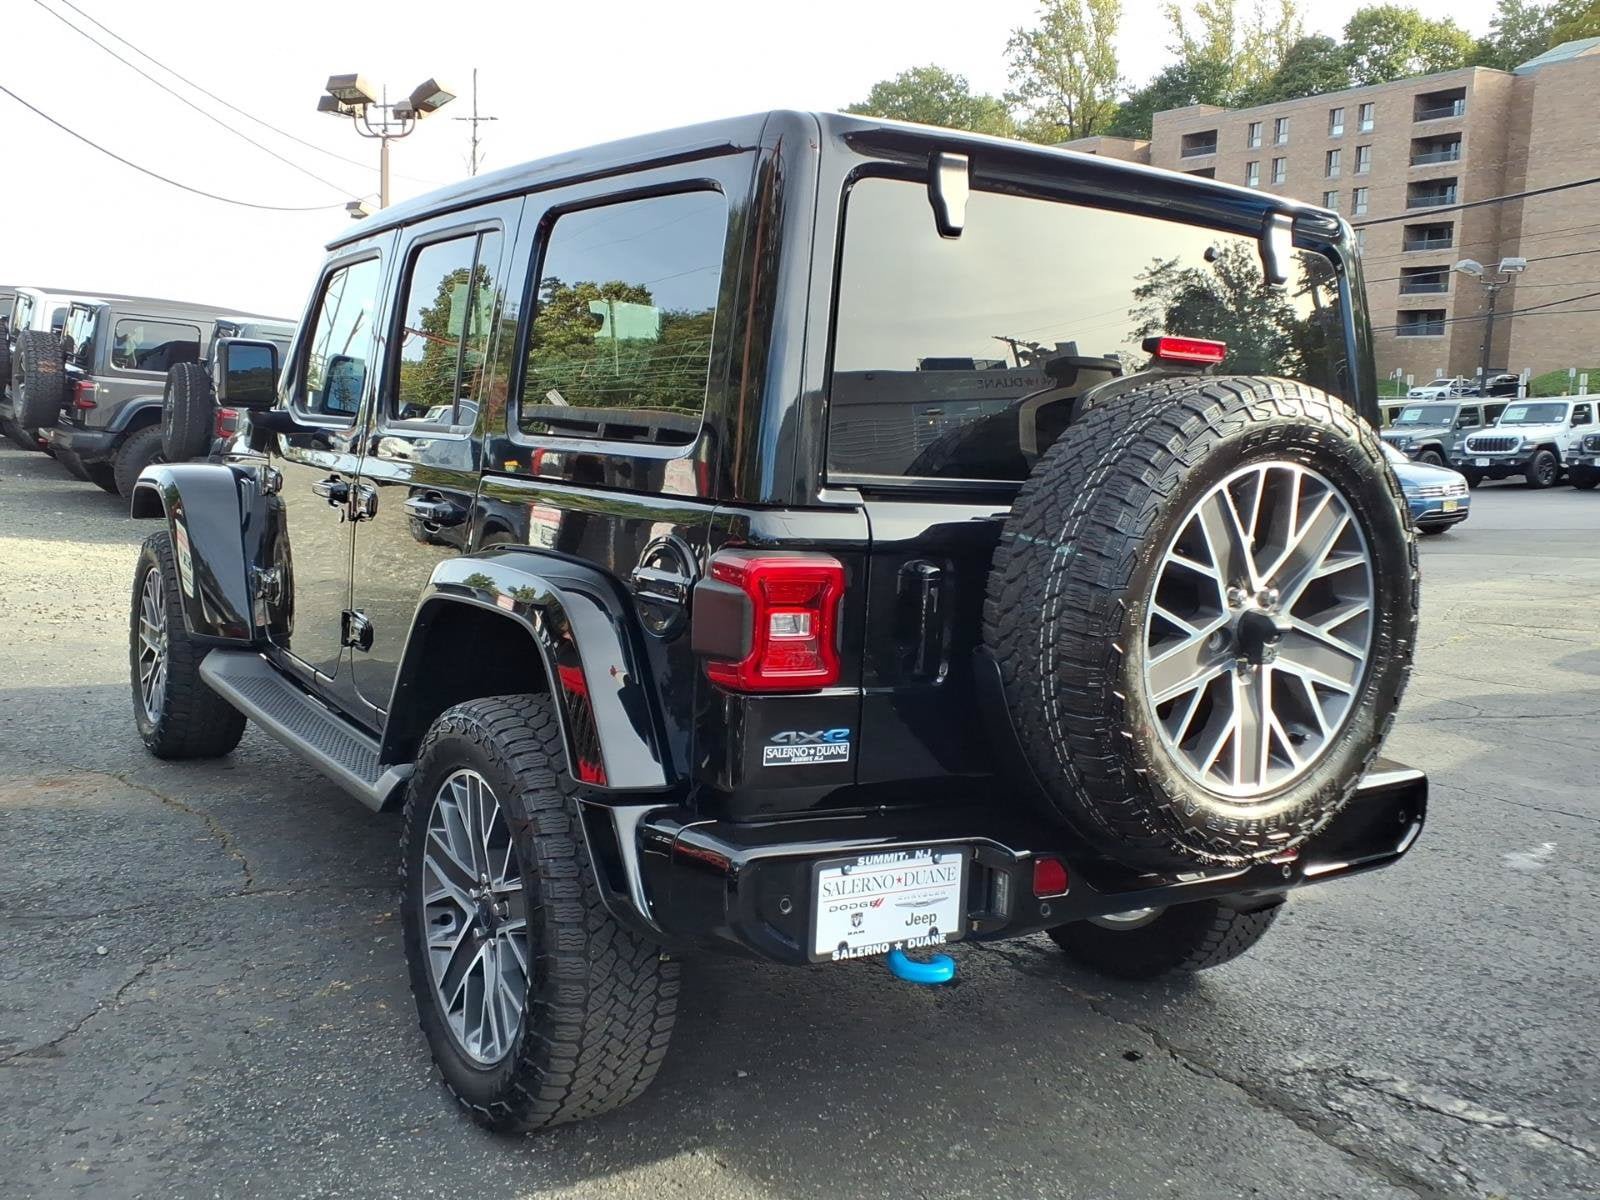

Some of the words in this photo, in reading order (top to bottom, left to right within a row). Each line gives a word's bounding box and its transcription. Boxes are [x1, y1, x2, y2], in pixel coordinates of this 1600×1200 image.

[766, 747, 808, 759] SALERNO
[816, 745, 847, 756] DUANE
[822, 874, 895, 898] SALERNO
[903, 866, 957, 887] DUANE
[829, 900, 876, 913] DODGE
[905, 912, 937, 926] Jeep
[831, 942, 890, 961] SALERNO
[907, 933, 947, 949] DUANE
